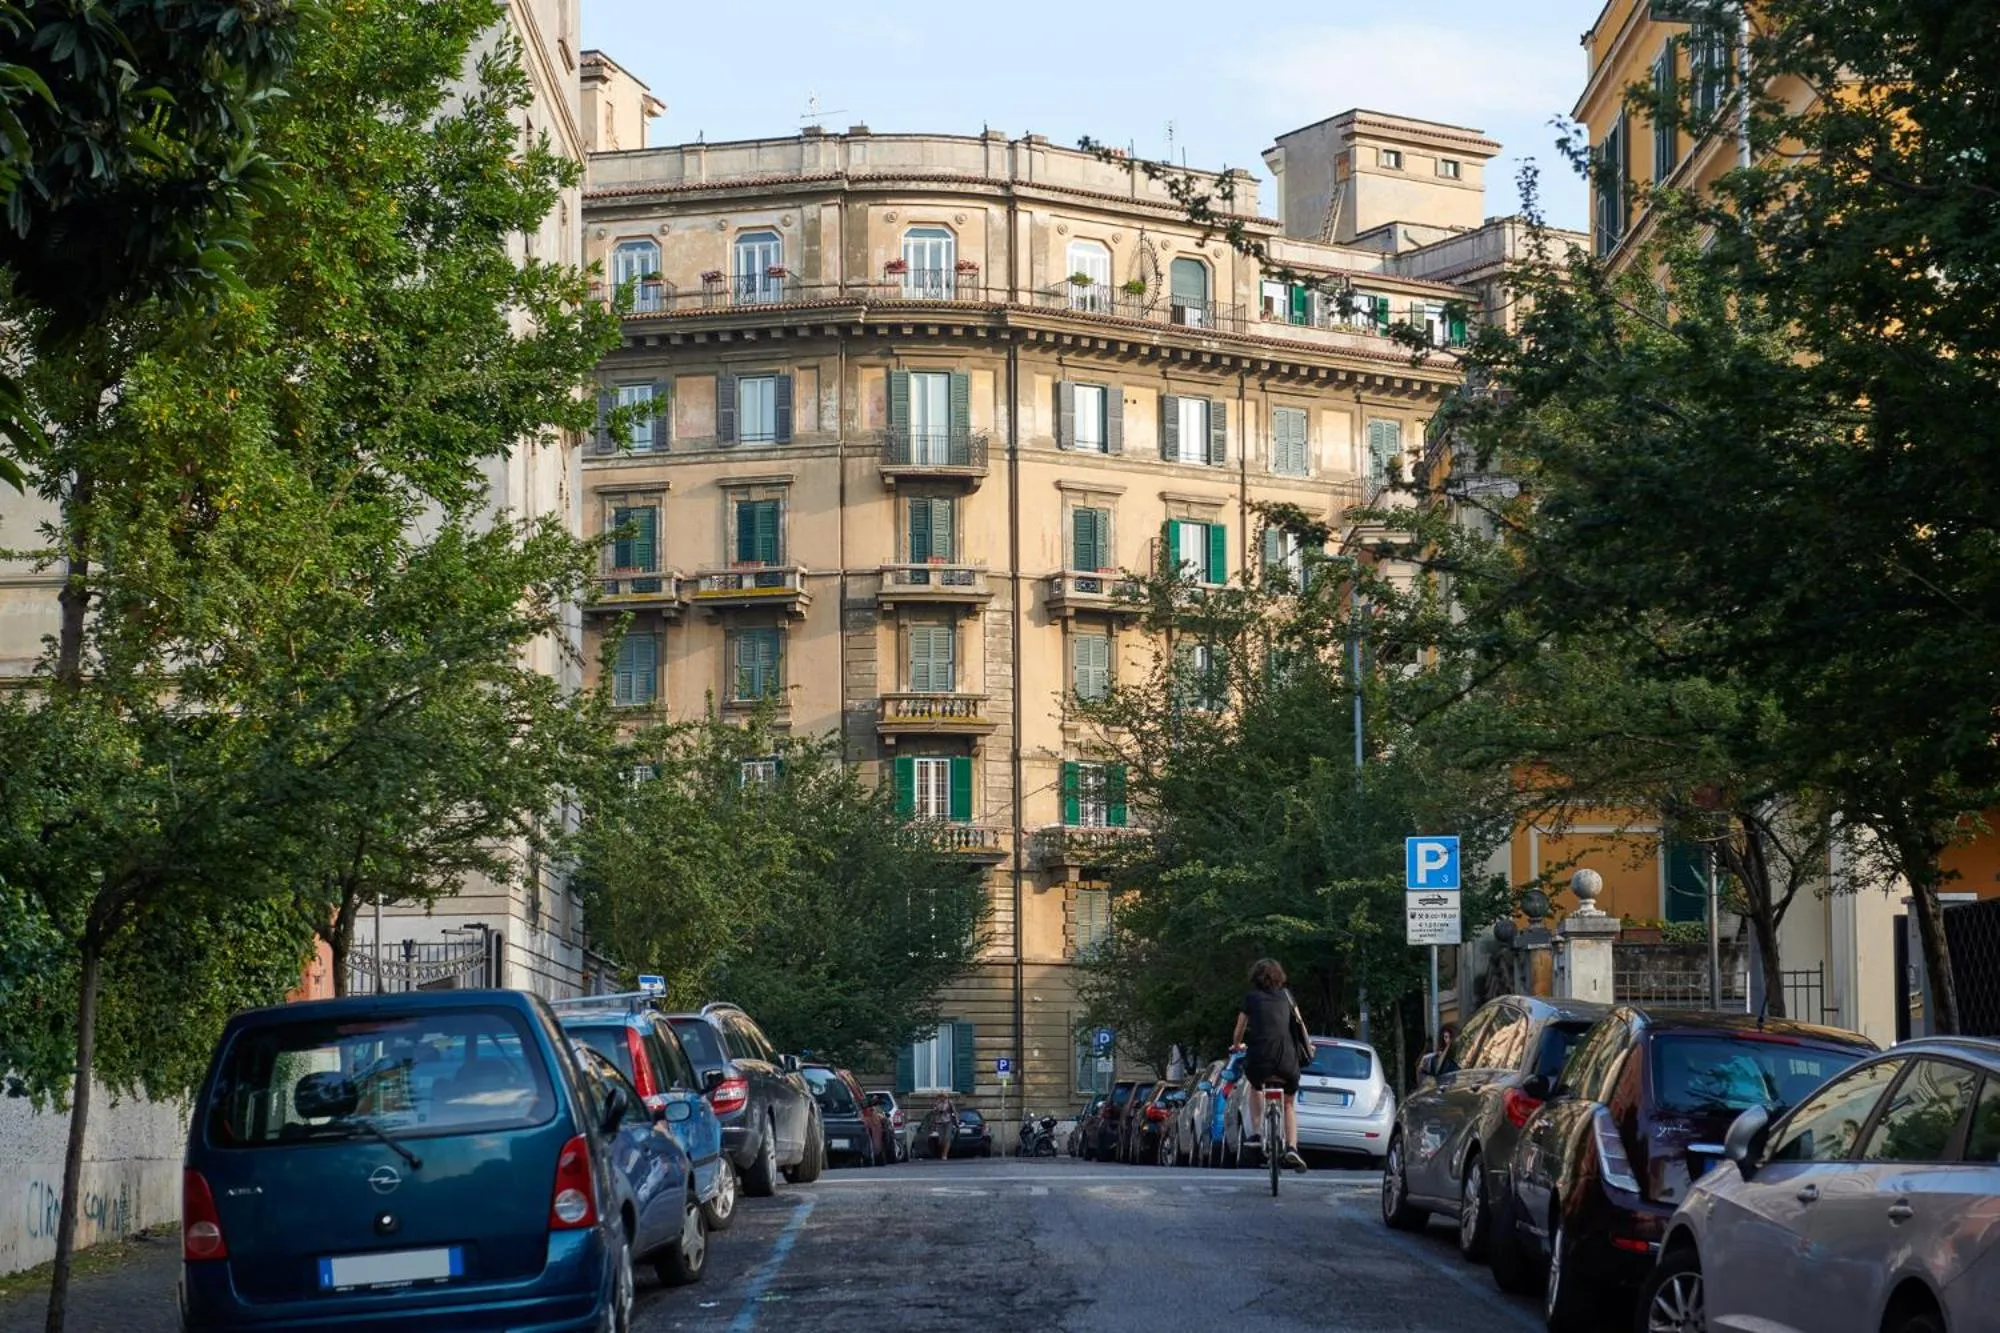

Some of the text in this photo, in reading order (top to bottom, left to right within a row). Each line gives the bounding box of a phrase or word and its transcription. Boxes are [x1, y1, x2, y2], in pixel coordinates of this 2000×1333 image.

[1417, 843, 1449, 884] P
[1441, 874, 1449, 883] 3
[1100, 1032, 1110, 1050] P
[999, 1059, 1008, 1070] P
